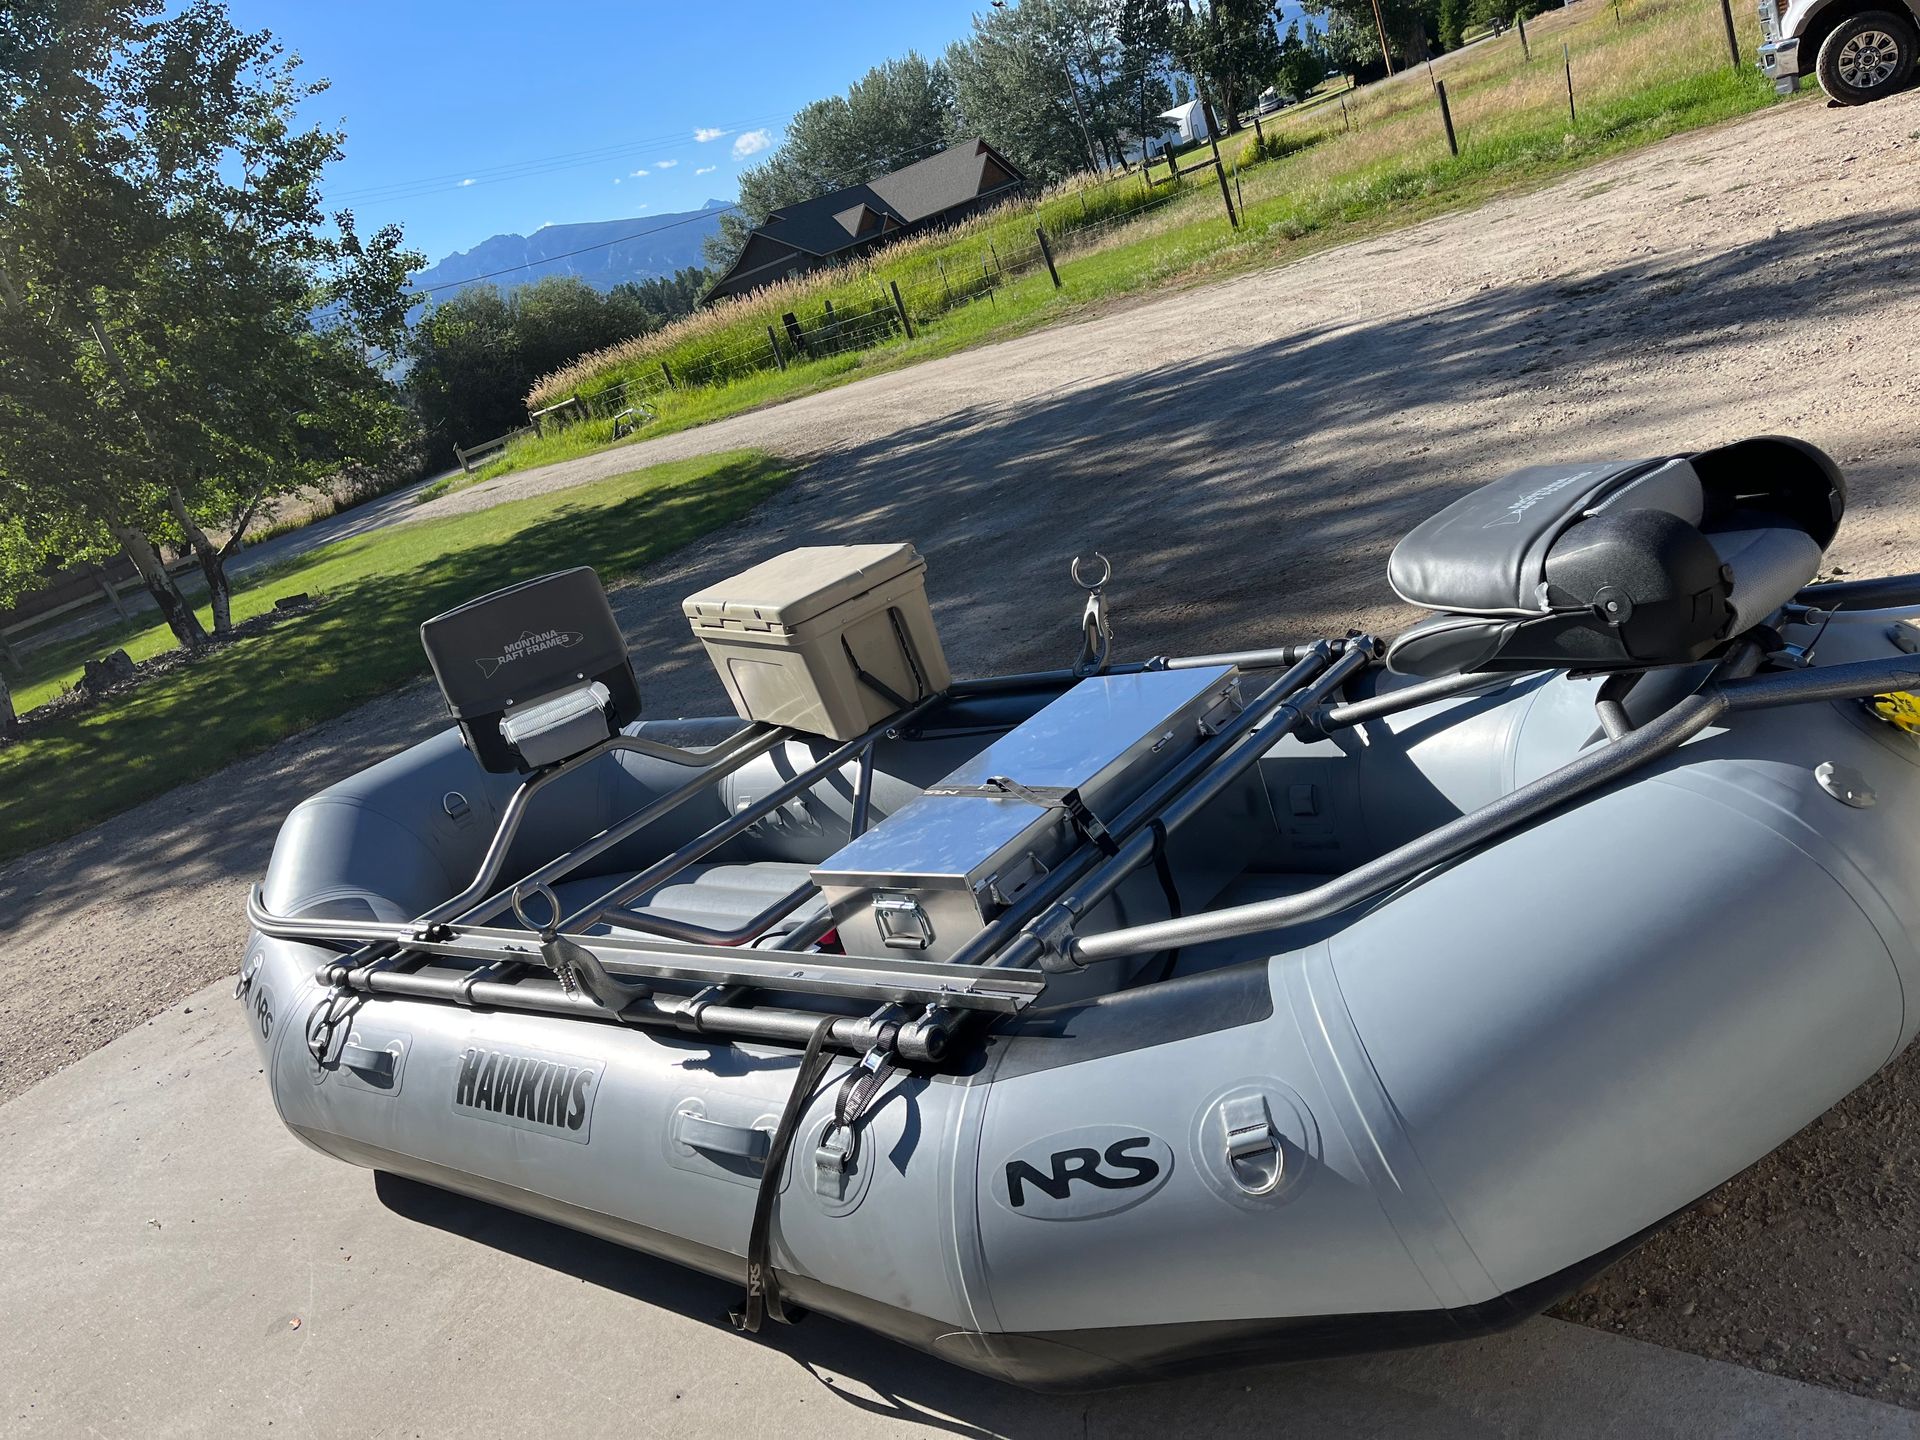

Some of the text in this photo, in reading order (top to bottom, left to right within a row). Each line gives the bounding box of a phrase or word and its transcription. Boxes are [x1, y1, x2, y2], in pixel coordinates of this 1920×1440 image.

[497, 634, 570, 664] RAFT FRAMES
[504, 629, 558, 654] MONTANA
[254, 986, 273, 1039] NRS
[456, 1047, 595, 1131] HAWKINS
[1006, 1136, 1160, 1208] NRS
[750, 1263, 761, 1297] NRS
